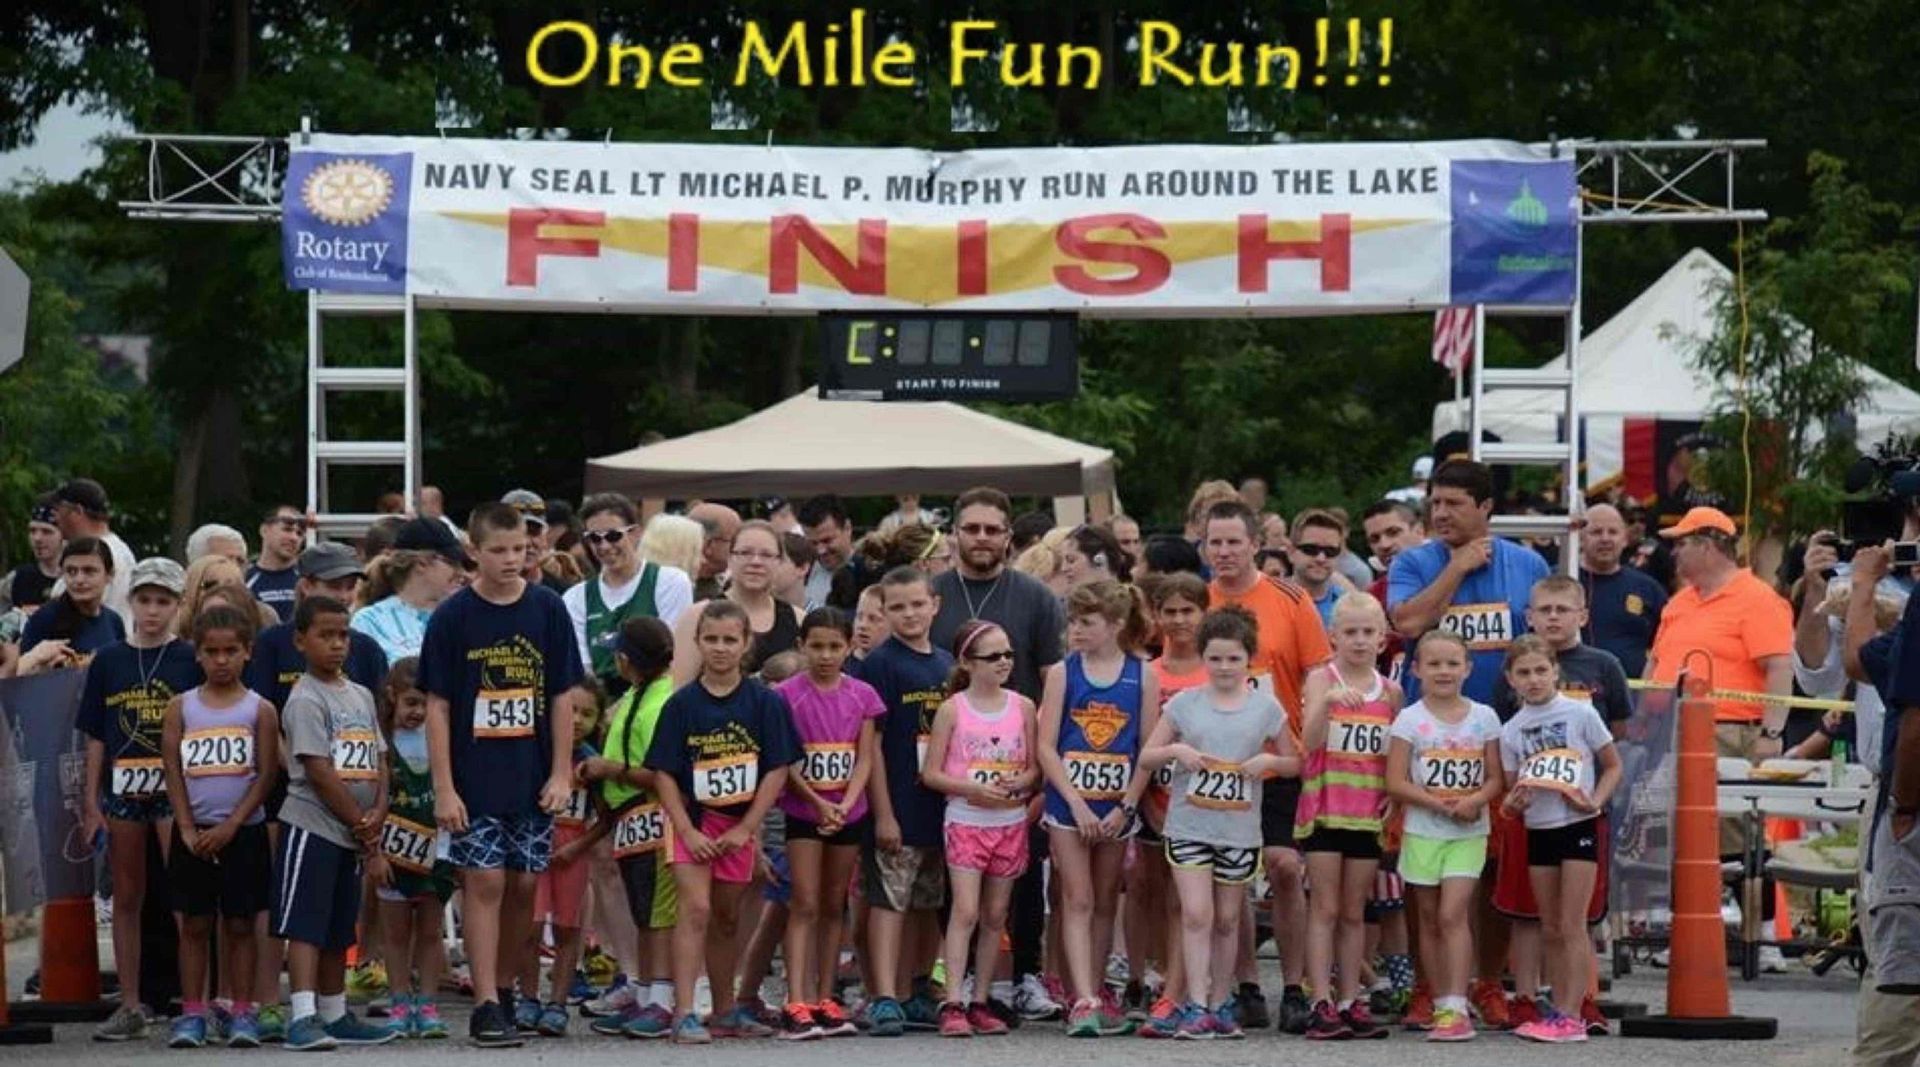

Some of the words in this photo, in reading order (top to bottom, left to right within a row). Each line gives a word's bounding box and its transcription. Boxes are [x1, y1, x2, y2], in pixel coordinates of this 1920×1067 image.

[424, 163, 515, 190] NAVY
[530, 167, 616, 195] SEAL
[629, 171, 666, 196] LT
[679, 171, 828, 200] MICHAEL
[842, 176, 870, 200] P.
[886, 174, 1027, 205] MURPHY
[1041, 171, 1106, 199] RUN
[1120, 169, 1258, 198] AROUND
[1272, 169, 1334, 195] THE
[1348, 166, 1438, 194] LAKE
[295, 231, 389, 270] Rotary
[506, 208, 1351, 296] FINISH
[896, 378, 937, 390] START
[940, 378, 956, 390] TO
[958, 378, 1000, 390] FINISH
[1446, 611, 1506, 641] 2644
[487, 699, 532, 727] 543
[187, 737, 248, 766] 2203
[1341, 723, 1382, 754] 766
[707, 764, 747, 797] 537
[800, 752, 851, 781] 2669
[1070, 760, 1125, 791] 2653
[1426, 758, 1482, 789] 2632
[1195, 768, 1245, 801] 2231
[380, 823, 433, 864] 1514
